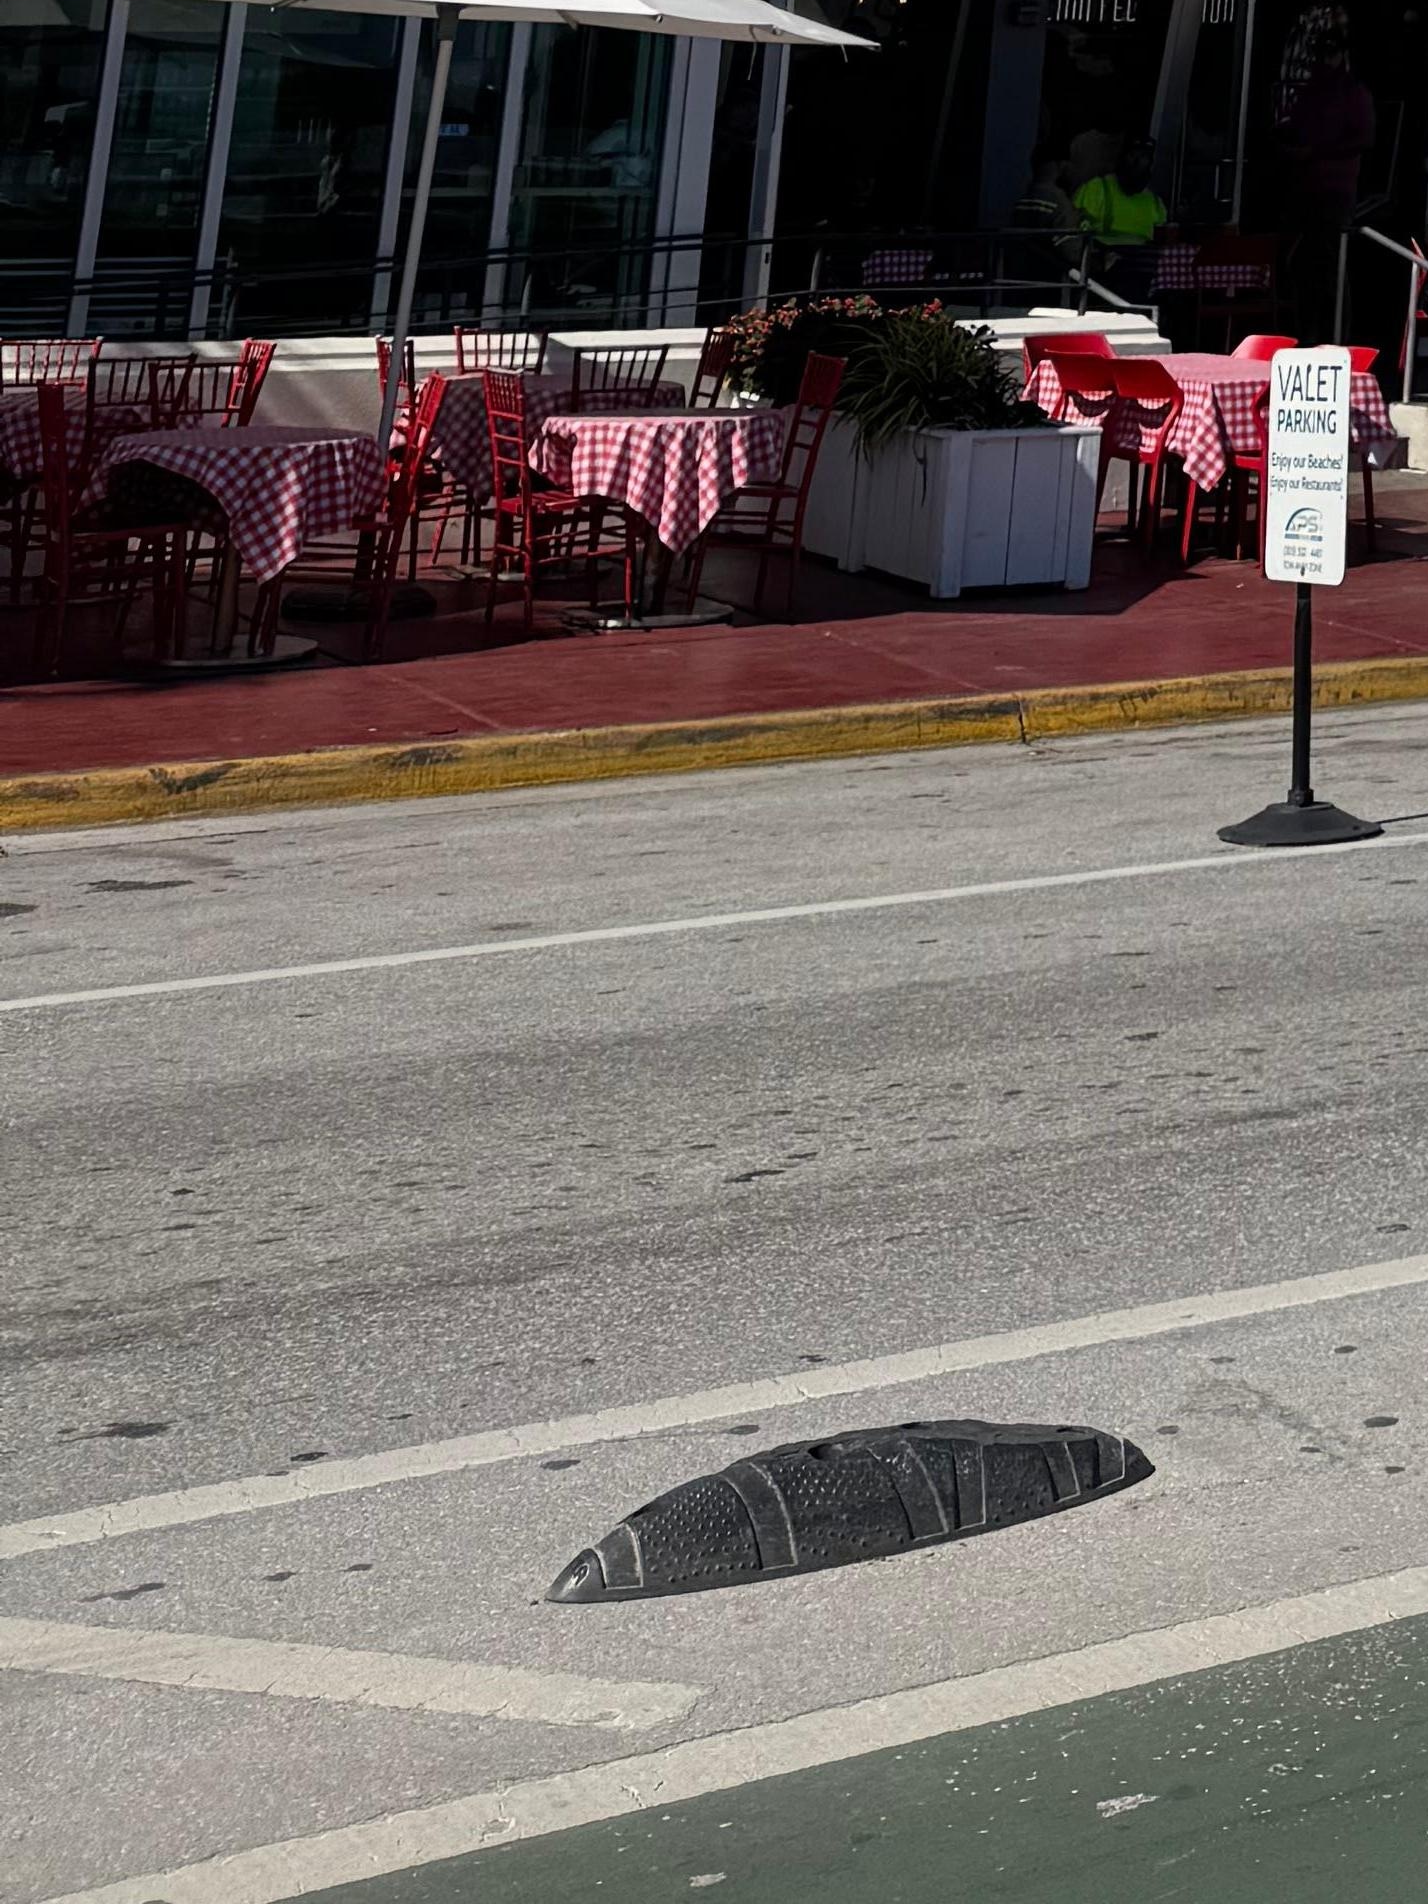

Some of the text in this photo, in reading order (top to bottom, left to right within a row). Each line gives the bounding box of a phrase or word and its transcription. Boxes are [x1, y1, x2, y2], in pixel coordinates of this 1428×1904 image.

[1278, 364, 1343, 402] VALET
[1277, 408, 1337, 434] PARKING
[1272, 452, 1292, 472] Enjoy
[1293, 457, 1306, 468] our
[1271, 476, 1288, 493] Enjoy
[1289, 480, 1301, 489] our
